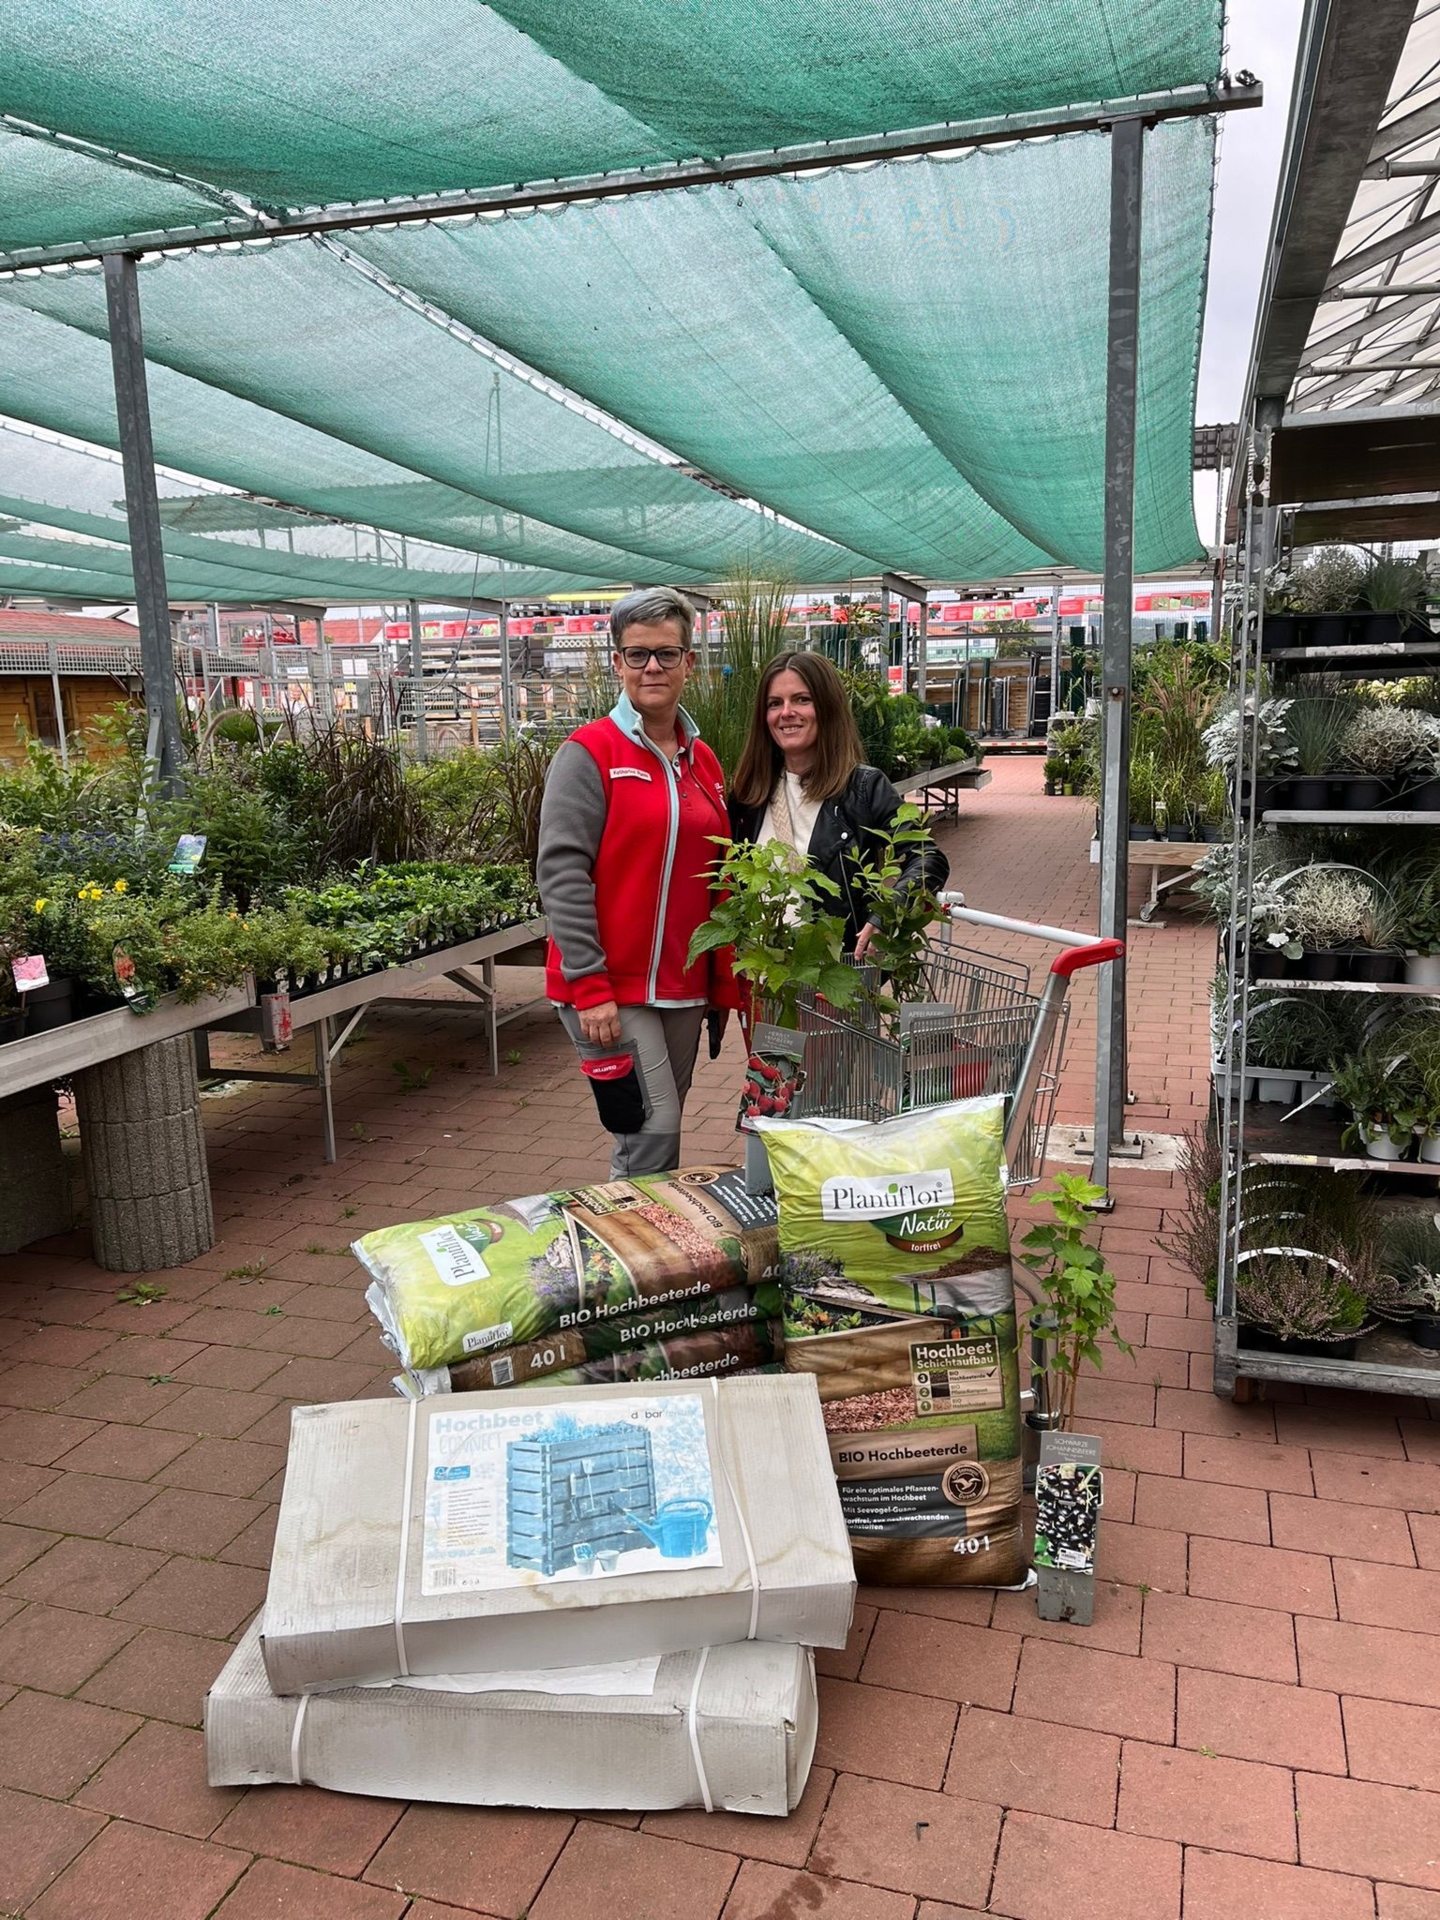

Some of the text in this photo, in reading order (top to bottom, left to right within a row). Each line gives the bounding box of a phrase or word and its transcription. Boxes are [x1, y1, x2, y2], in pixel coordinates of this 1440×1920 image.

[833, 1184, 943, 1210] Plantiflor
[705, 1212, 723, 1229] BIO
[937, 1208, 952, 1218] Pro
[900, 1212, 954, 1237] Natur
[438, 1230, 475, 1279] Plantiflor
[911, 1240, 942, 1252] torffrei
[559, 1280, 711, 1328] BIO Hochbeeterde
[620, 1303, 758, 1343] BIO Hochbeeterde
[530, 1349, 556, 1368] 40
[915, 1342, 992, 1360] Hochbeet
[630, 1353, 740, 1382] chbeeterde
[916, 1355, 994, 1369] Schichtaufbau
[435, 1411, 544, 1434] Hochbeet
[1045, 1444, 1097, 1456] JOHANNISBEERE
[1054, 1437, 1089, 1448] SCHWARZE
[838, 1443, 968, 1463] BIO Hochbeeterde
[842, 1484, 939, 1495] Für ein optimales Pflanzen-
[880, 1494, 890, 1502] im
[891, 1494, 927, 1502] Hochbeet
[843, 1506, 917, 1516] Mit Seevogel-Guano
[953, 1538, 980, 1555] 40
